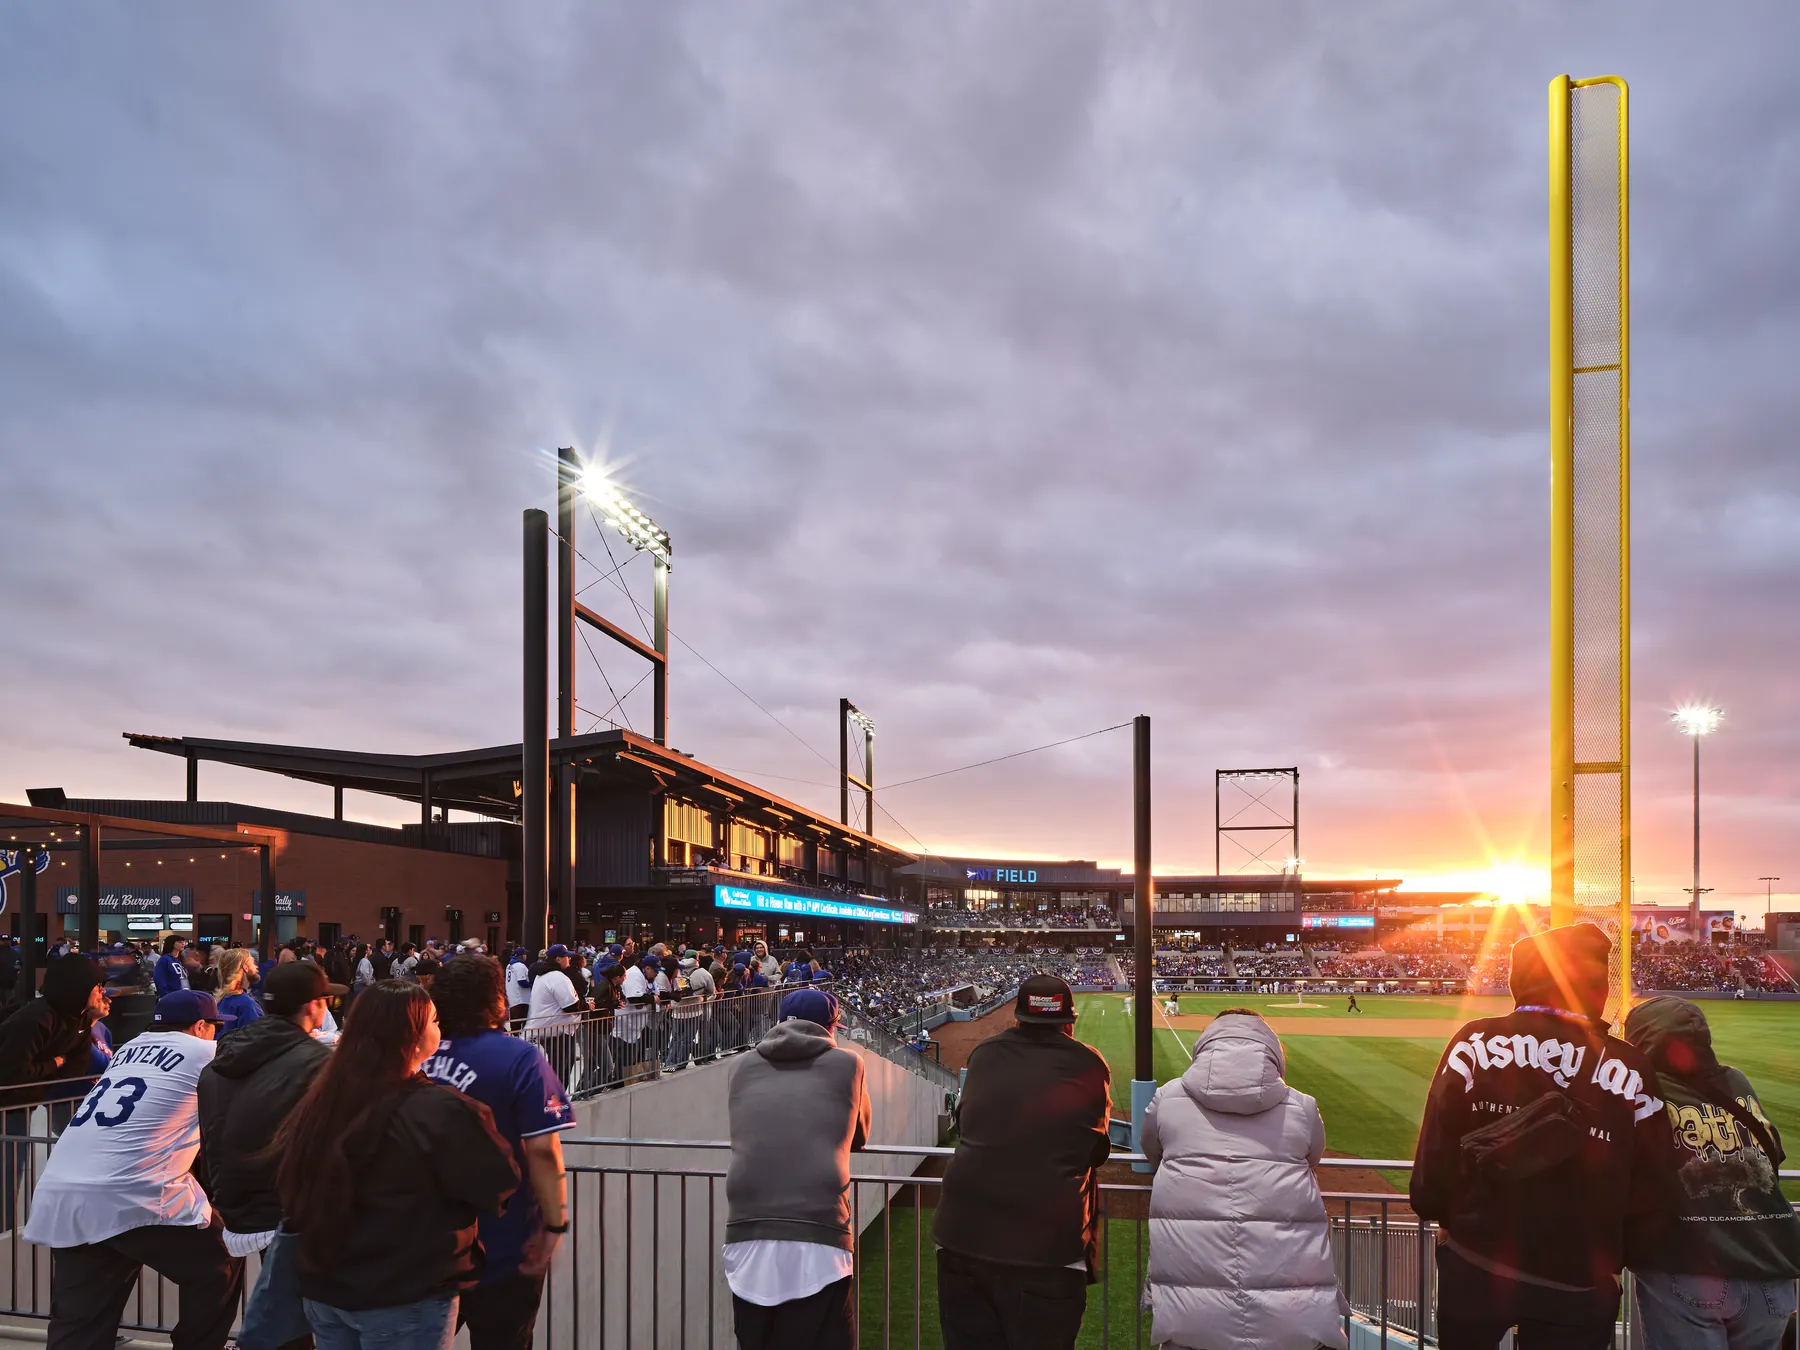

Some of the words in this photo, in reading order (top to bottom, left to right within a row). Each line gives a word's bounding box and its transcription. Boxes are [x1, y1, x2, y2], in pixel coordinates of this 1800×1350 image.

[996, 868, 1037, 883] FIELD
[98, 894, 119, 910] ally
[121, 894, 161, 910] Burger
[69, 1076, 148, 1127] 33
